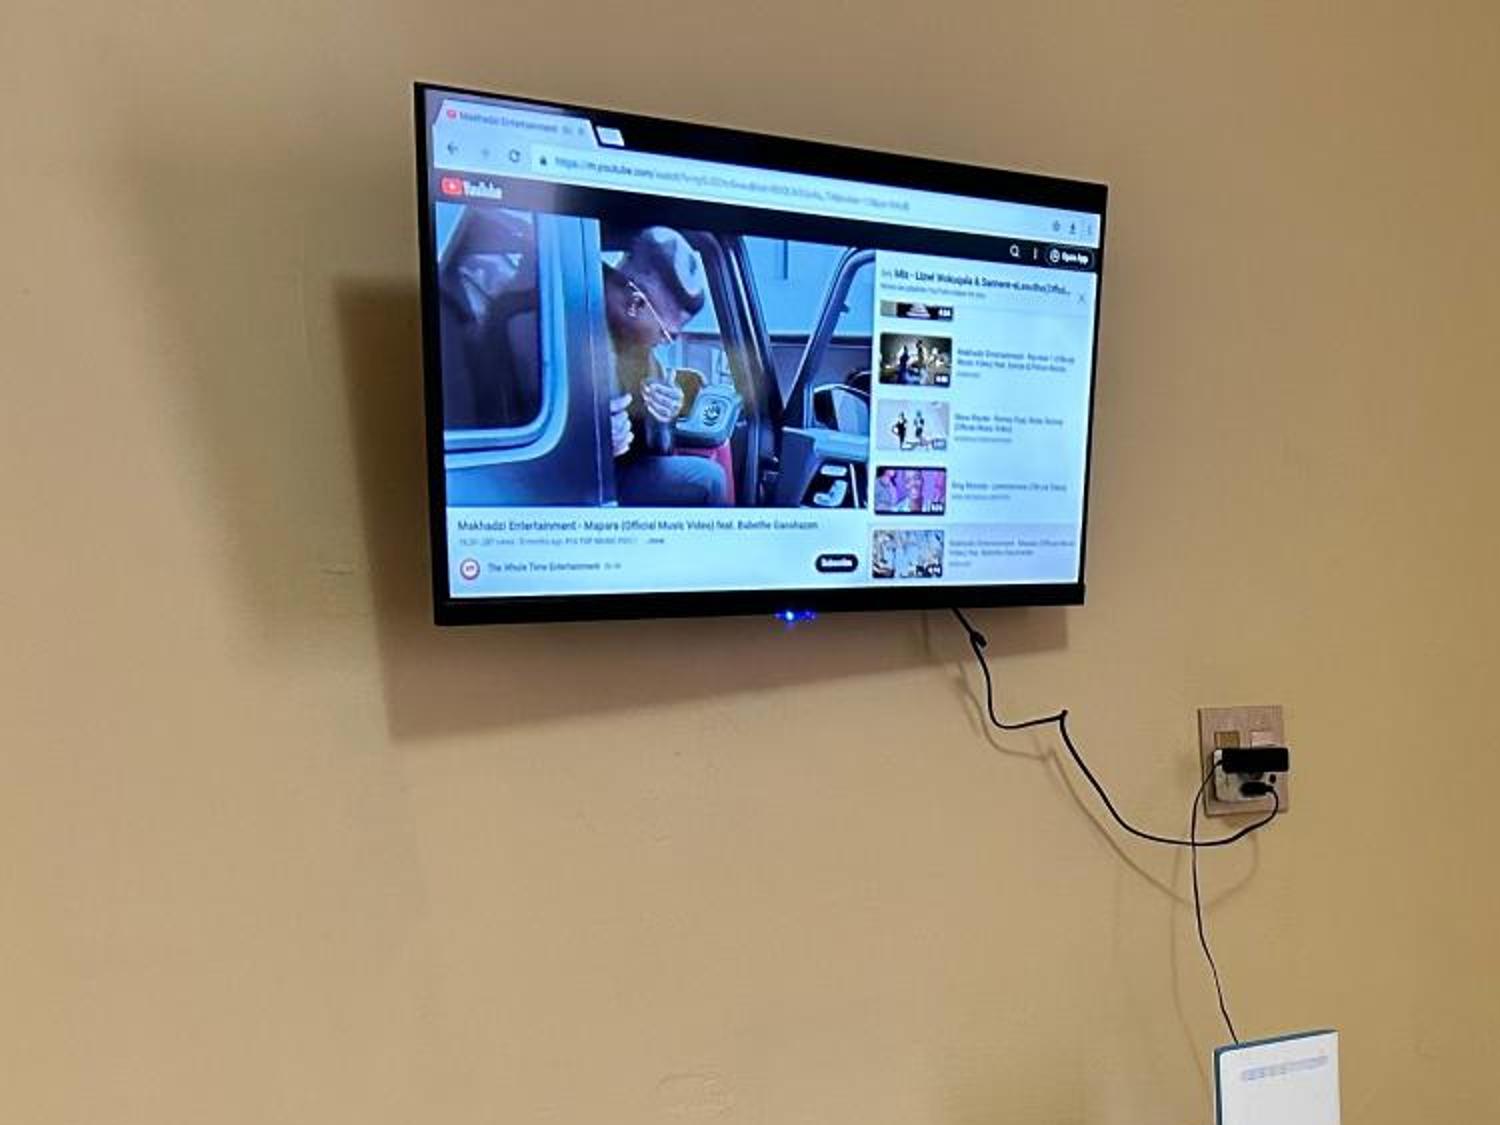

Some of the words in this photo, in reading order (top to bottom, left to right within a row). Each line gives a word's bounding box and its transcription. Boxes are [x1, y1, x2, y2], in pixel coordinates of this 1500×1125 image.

[458, 520, 506, 531] Makhadzi
[509, 520, 576, 531] Entertainment
[658, 520, 684, 530] Music
[488, 562, 502, 572] The
